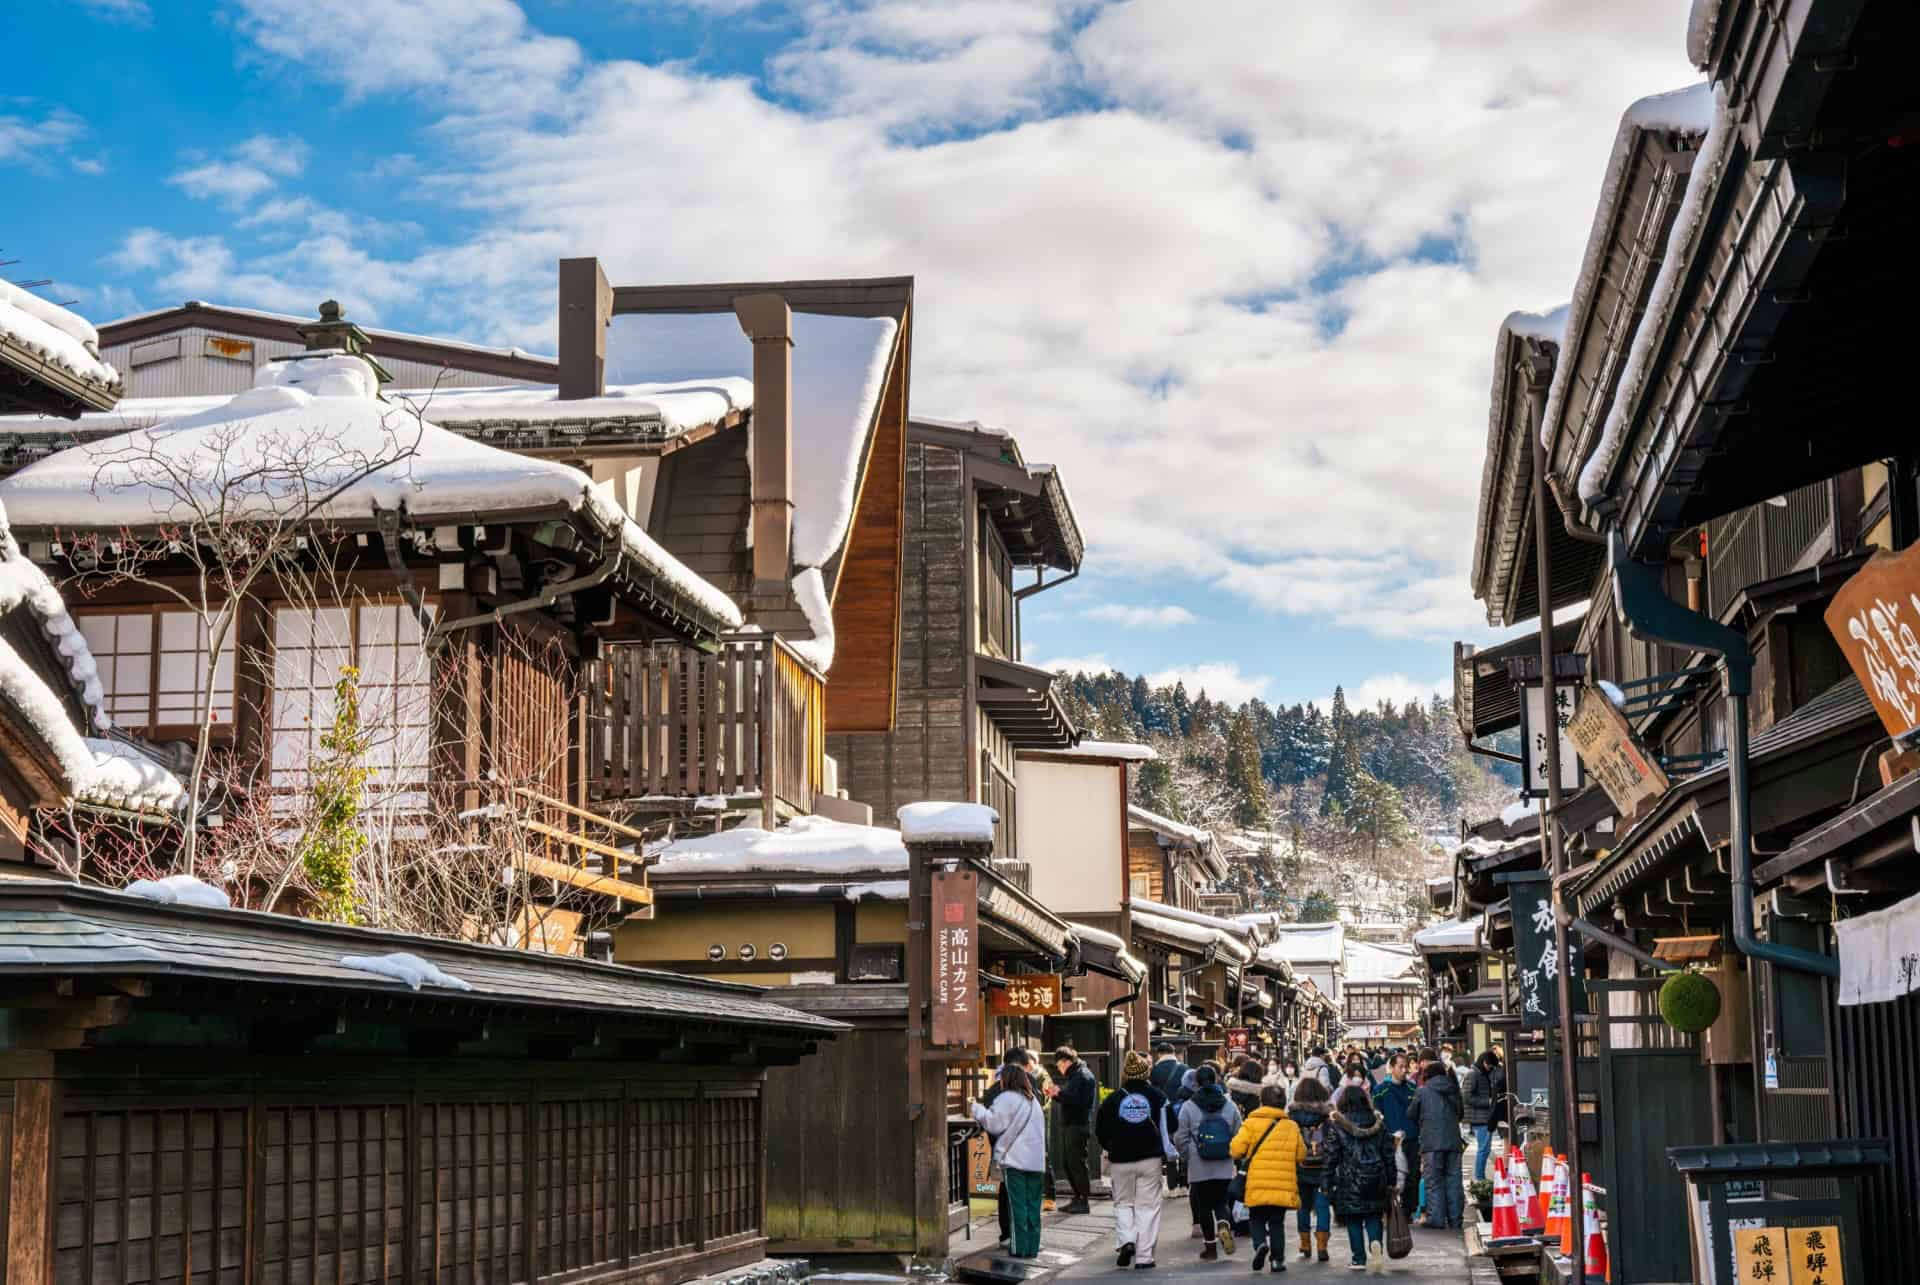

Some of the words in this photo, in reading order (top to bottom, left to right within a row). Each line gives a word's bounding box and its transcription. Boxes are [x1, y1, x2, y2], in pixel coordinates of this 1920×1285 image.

[939, 928, 948, 976] TAKAYAMA
[951, 928, 969, 1012] 高山カフェ
[939, 979, 948, 1004] CAFE
[1008, 986, 1053, 1008] 地酒
